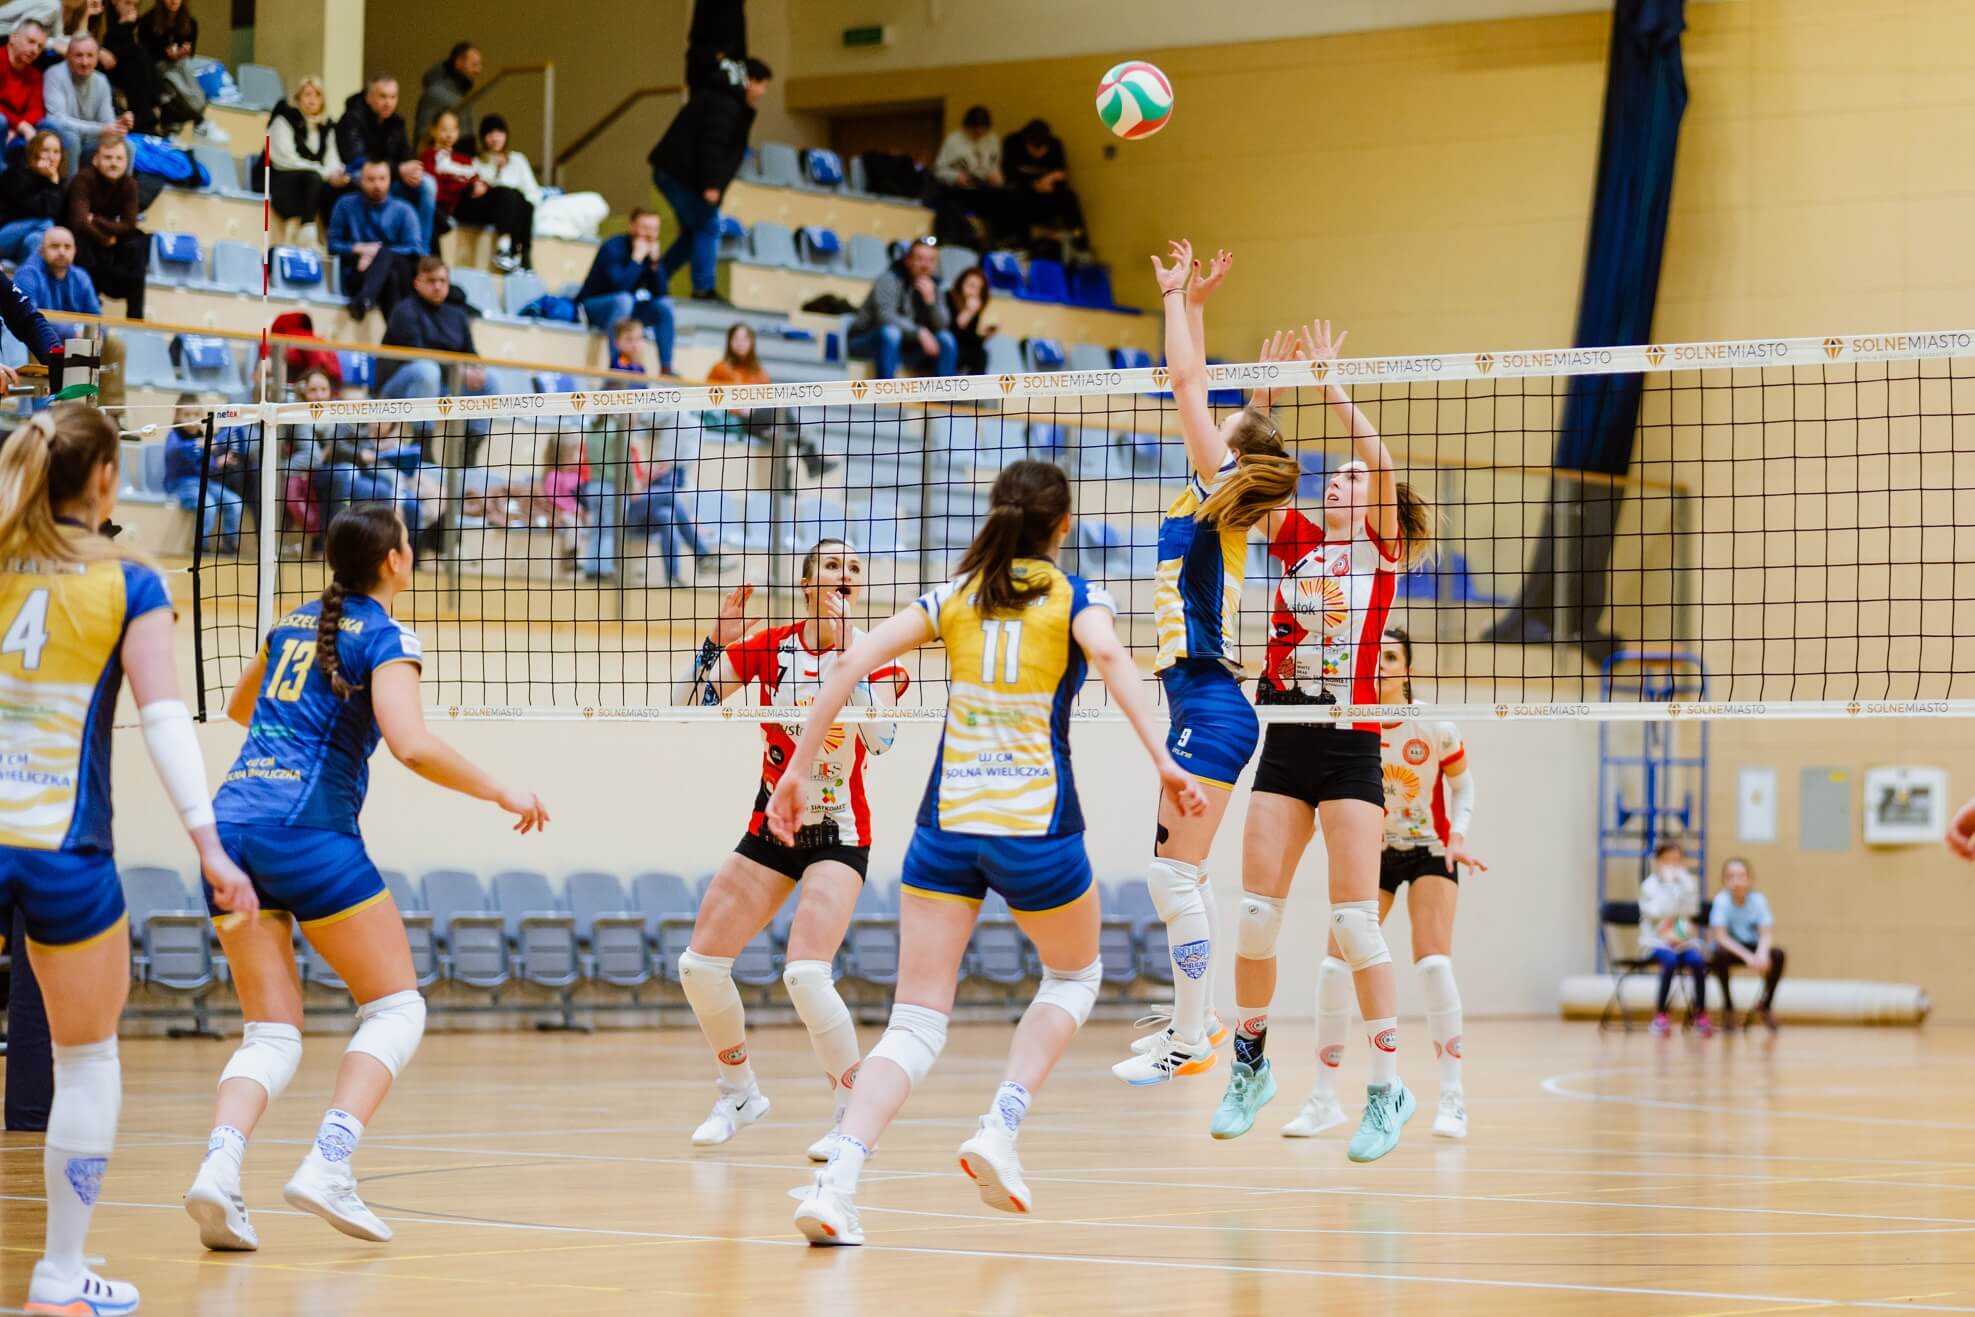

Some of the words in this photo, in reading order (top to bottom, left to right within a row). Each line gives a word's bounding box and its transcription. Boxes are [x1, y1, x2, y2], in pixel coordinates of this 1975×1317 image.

[1673, 342, 1788, 361] SOLNEMIASTO
[1852, 333, 1970, 353] SOLNEMIASTO
[1336, 358, 1442, 376] SOLNEMIASTO
[1502, 350, 1612, 369] SOLNEMIASTO
[1023, 372, 1122, 389] SOLNEMIASTO
[1206, 365, 1279, 383] NEMIASTO
[731, 384, 824, 402] SOLNEMIASTO
[874, 378, 970, 395] SOLNEMIASTO
[458, 396, 545, 412] SOLNEMIASTO
[592, 390, 681, 407] SOLNEMIASTO
[329, 402, 413, 416] SOLNEMIASTO
[2, 588, 49, 671] 4
[981, 619, 1022, 684] 11
[266, 639, 317, 701] 13
[463, 707, 523, 717] SOLNEMIASTO
[598, 708, 660, 718] SOLNEMIASTO
[737, 708, 801, 718] SOLNEMIASTO
[1347, 706, 1421, 717] SOLNEMIASTO
[1514, 705, 1590, 716] SOLNEMIASTO
[1687, 704, 1766, 715] SOLNEMIASTO
[1866, 702, 1949, 713] SOLNEMIASTO
[1177, 728, 1192, 748] 9
[996, 752, 1013, 763] CM
[946, 767, 982, 779] SOLNA
[986, 766, 1050, 778] WIELICZKA
